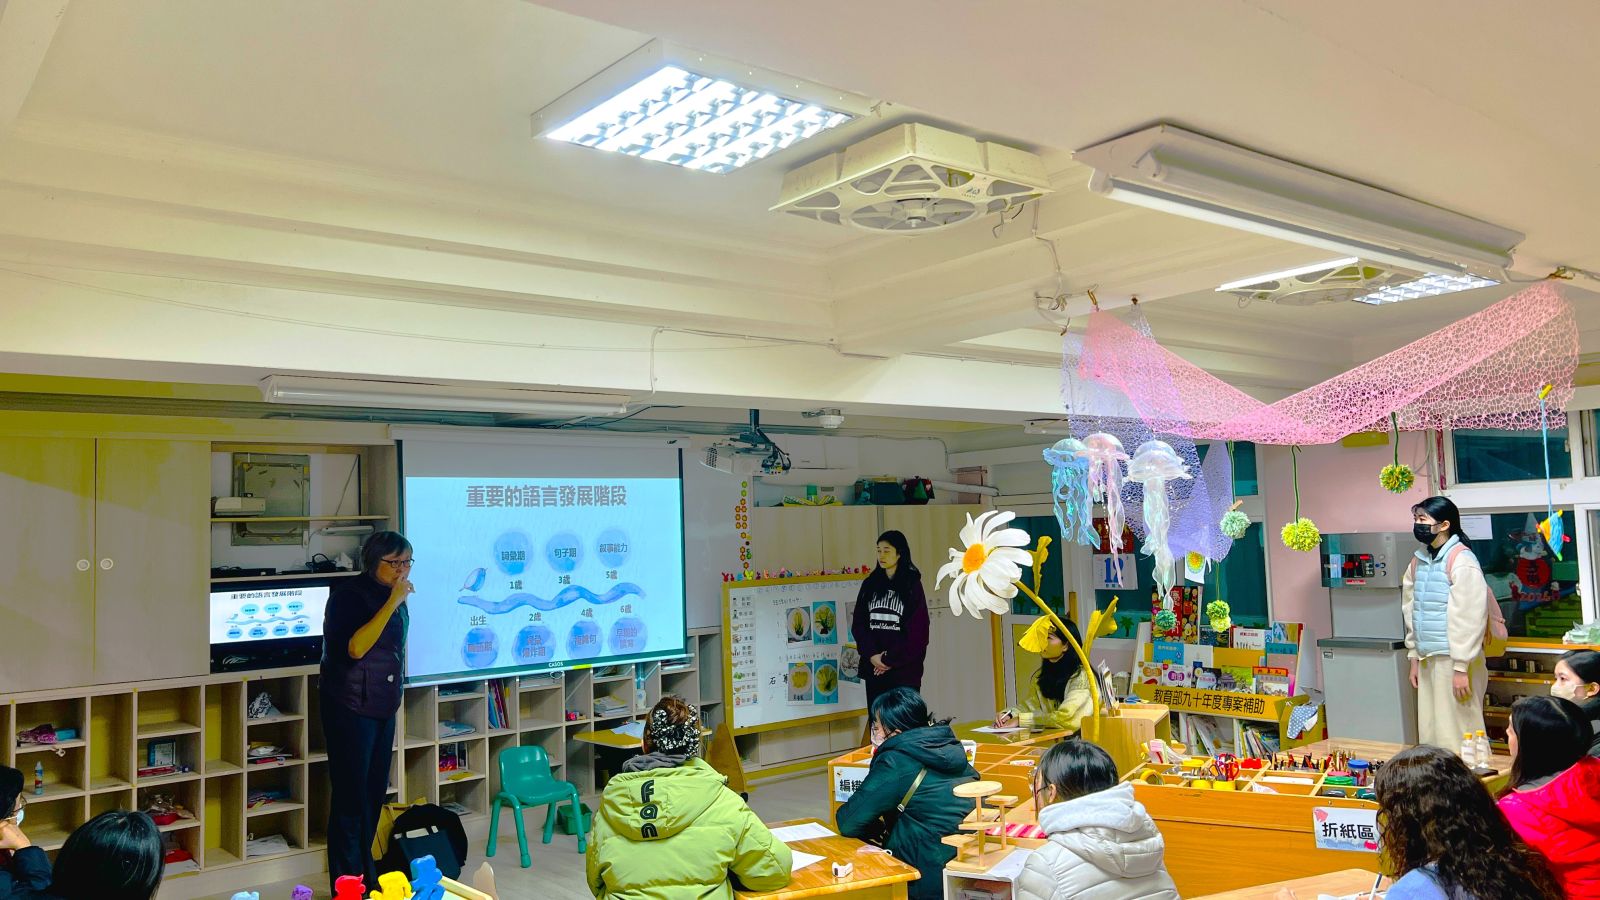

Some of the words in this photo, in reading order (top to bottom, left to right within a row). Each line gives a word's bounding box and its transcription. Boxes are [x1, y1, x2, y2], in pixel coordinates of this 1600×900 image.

[466, 485, 627, 507] 重要的語言發展階段
[554, 547, 576, 558] 句子期
[558, 574, 571, 585] 3歲
[605, 570, 618, 580] 5歲
[509, 579, 523, 590] 1歲
[470, 615, 487, 626] 出生
[528, 611, 542, 622] 2歲
[1154, 688, 1266, 715] 教育部九十年度專案補助
[1321, 821, 1375, 841] 折紙區
